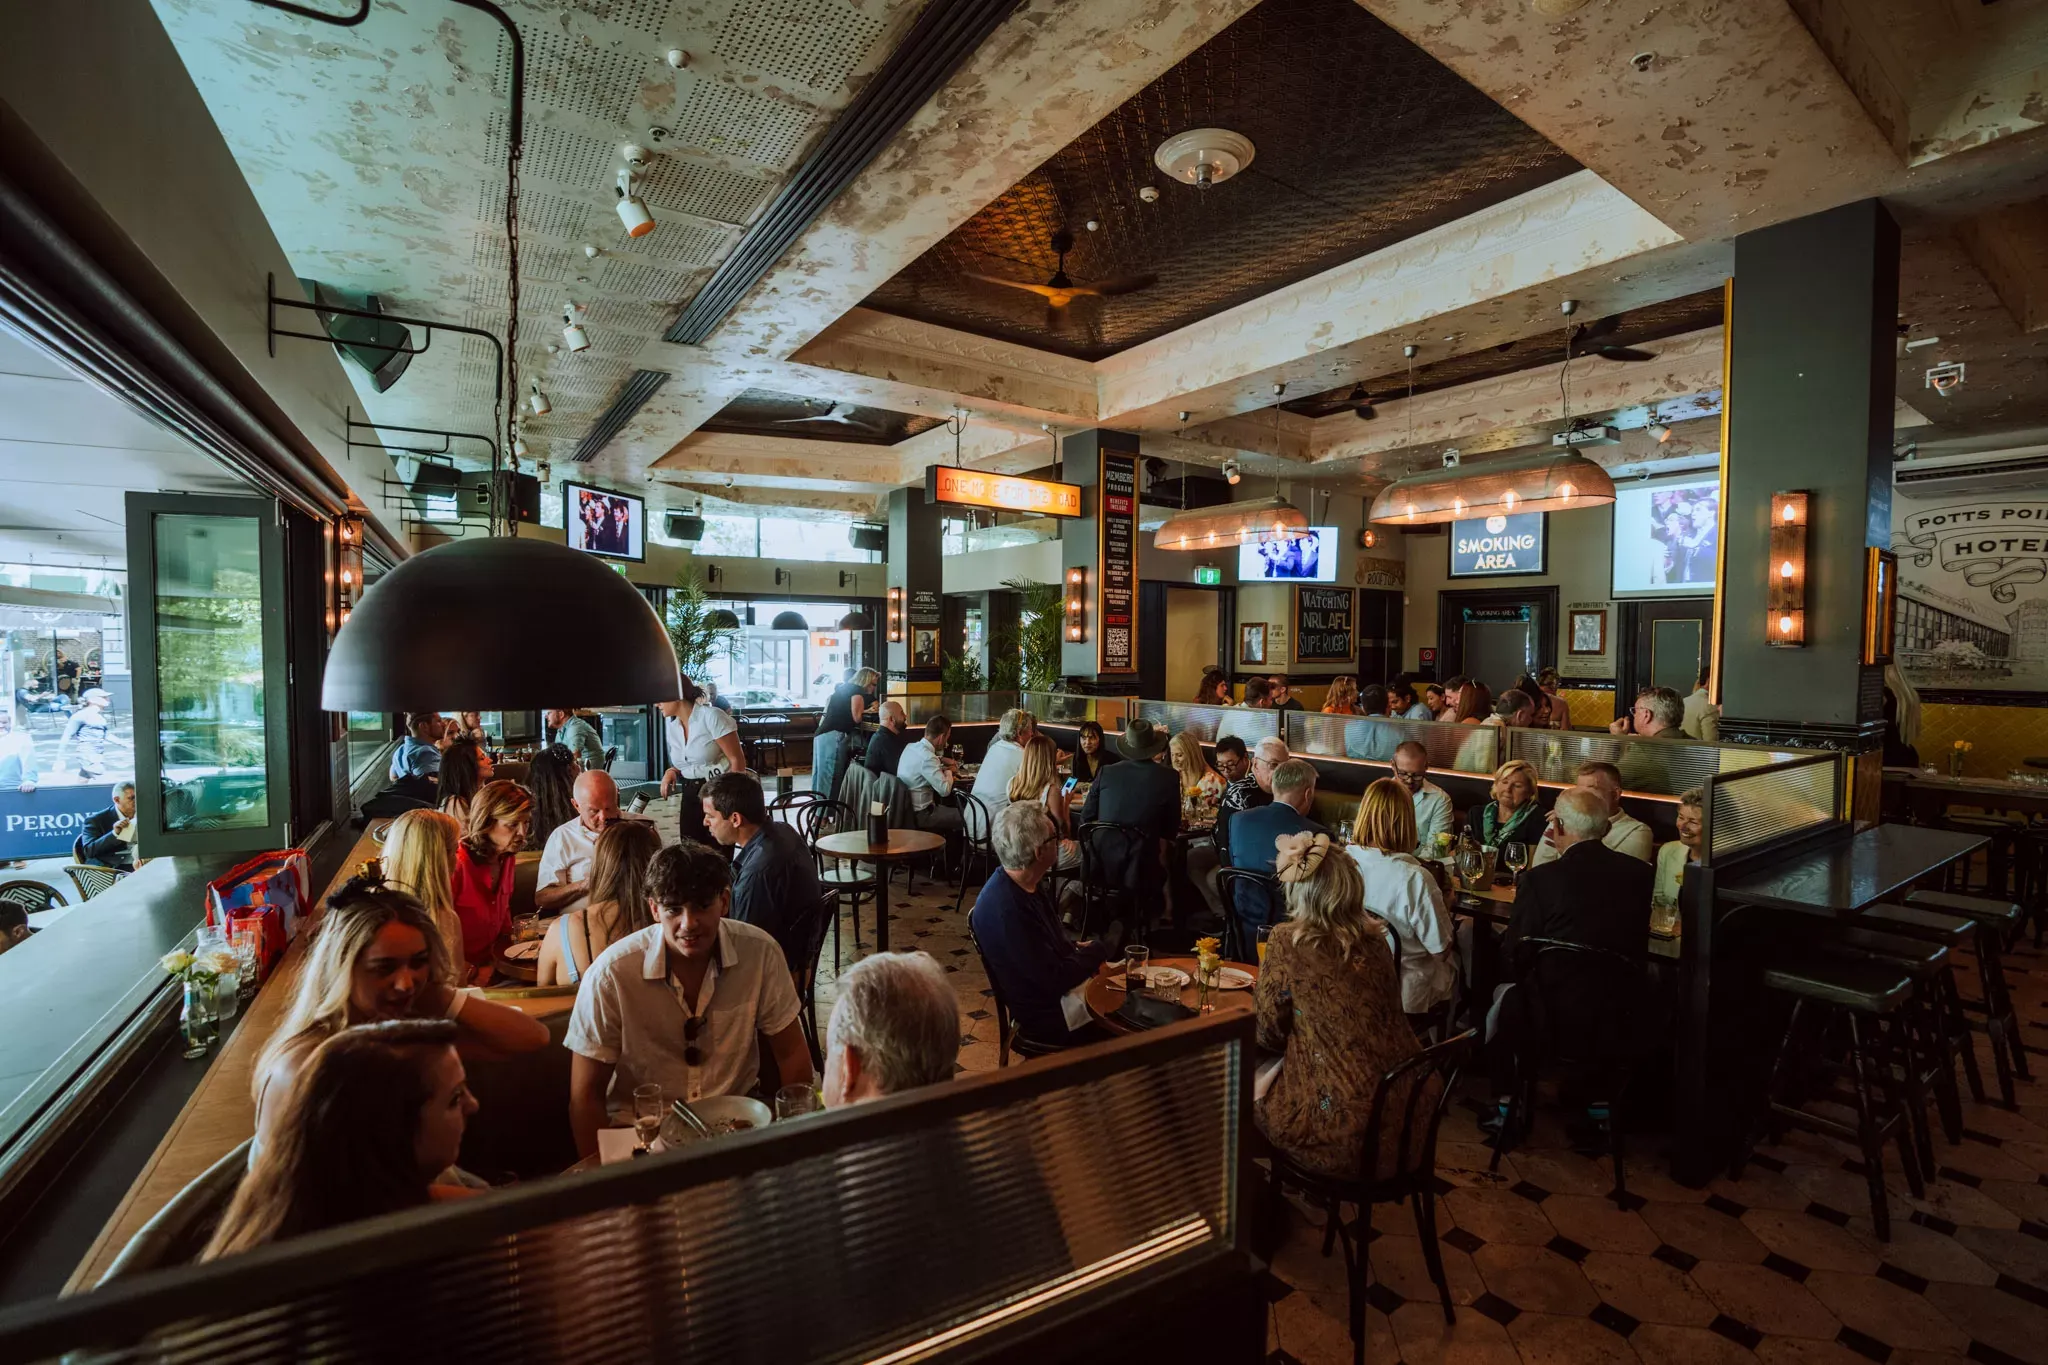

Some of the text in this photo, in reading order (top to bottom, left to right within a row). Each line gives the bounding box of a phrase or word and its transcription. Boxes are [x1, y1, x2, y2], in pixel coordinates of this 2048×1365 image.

[1106, 470, 1133, 483] MEMBERS
[1107, 483, 1132, 493] PROGRAM
[1918, 508, 2048, 529] POTTS POI
[1458, 535, 1535, 553] SMOKING
[1474, 553, 1516, 569] AREA
[1367, 572, 1396, 586] ROOFTOP
[1302, 592, 1349, 609] WATCHING
[1303, 612, 1351, 630] NRL AFL
[1322, 632, 1351, 653] RUGBY
[6, 812, 97, 832] PERON
